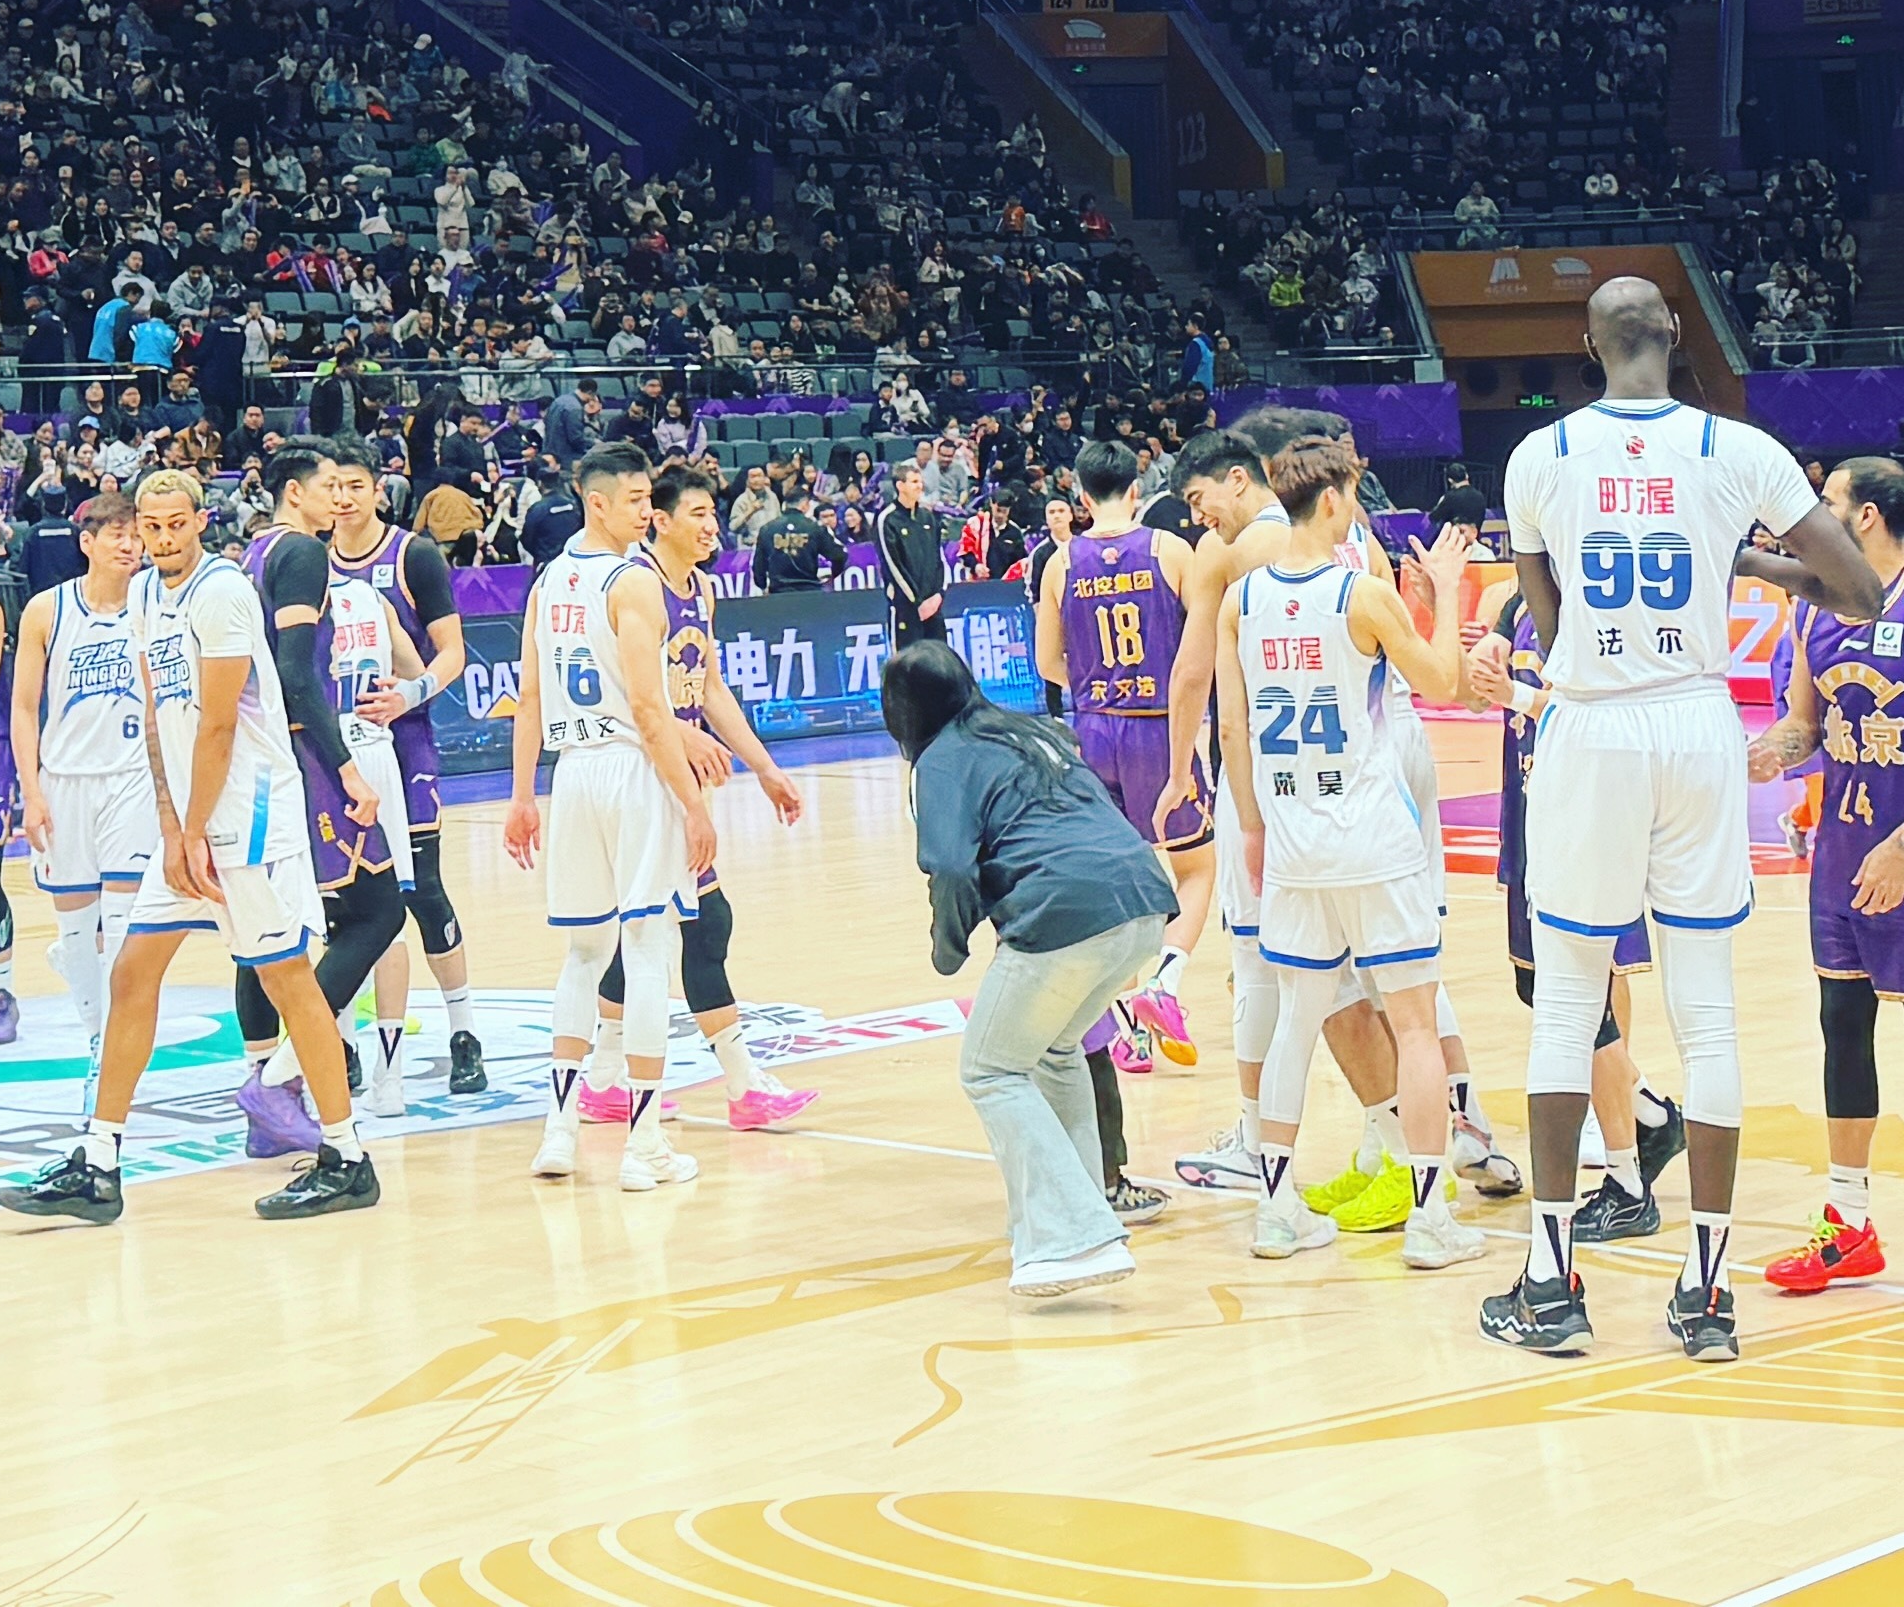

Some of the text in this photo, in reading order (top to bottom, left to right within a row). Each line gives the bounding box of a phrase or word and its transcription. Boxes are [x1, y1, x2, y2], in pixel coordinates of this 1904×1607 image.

[1598, 477, 1675, 515] 町渥
[1072, 568, 1154, 600] 北控集团
[1580, 530, 1693, 610] 99
[1095, 601, 1146, 669] 18
[1597, 627, 1684, 657] 法尔
[714, 628, 817, 701] 电力
[1261, 636, 1325, 672] 町渥
[67, 659, 133, 691] NINGBO
[553, 646, 603, 707] 16
[1090, 675, 1157, 702] 宋文浩
[122, 713, 141, 739] 6
[1255, 684, 1349, 756] 24
